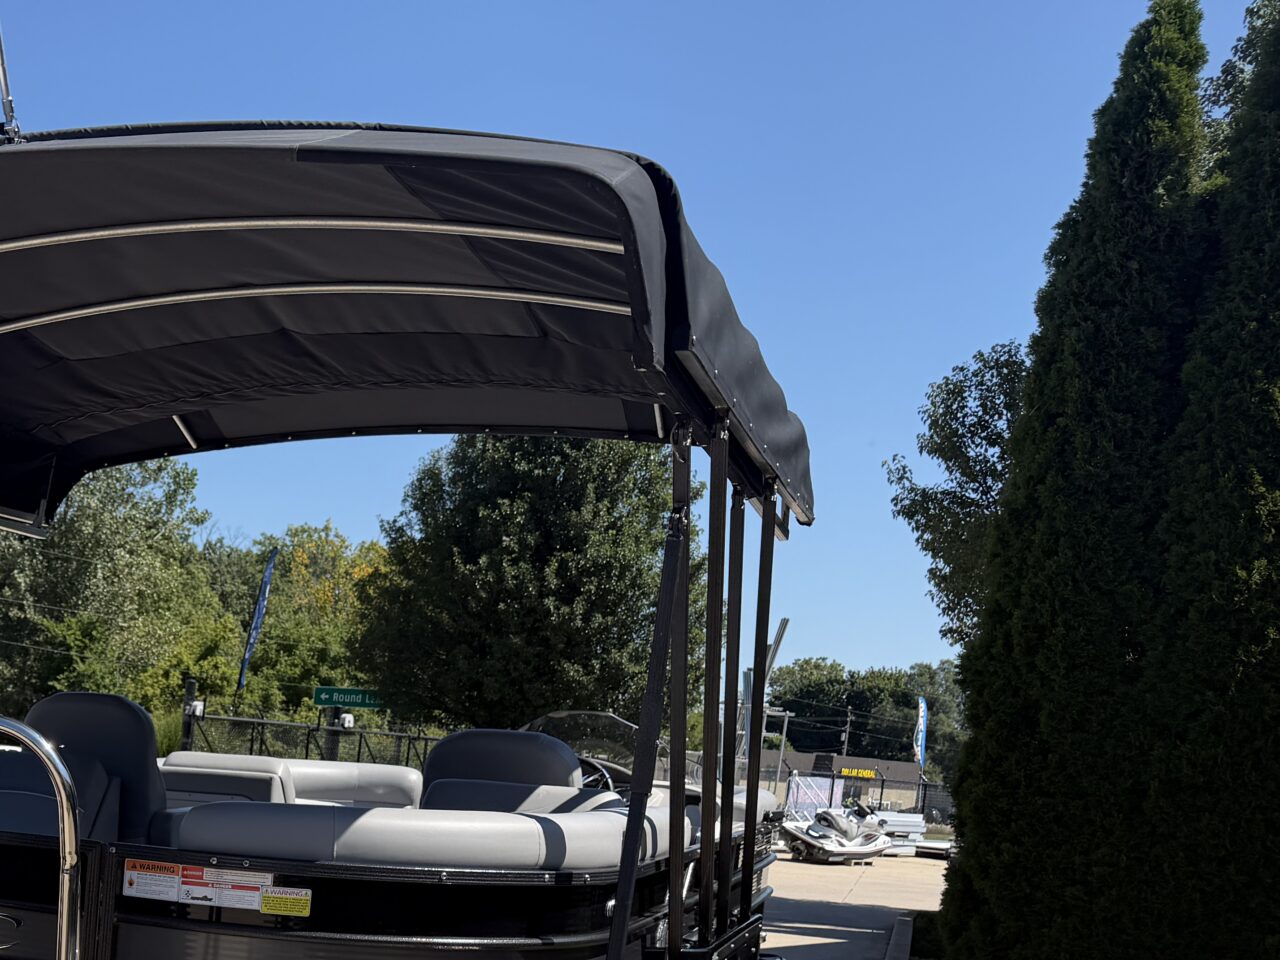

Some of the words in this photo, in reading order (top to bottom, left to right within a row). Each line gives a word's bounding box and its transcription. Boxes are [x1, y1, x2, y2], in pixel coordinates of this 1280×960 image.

[332, 692, 362, 703] Round
[139, 863, 175, 873] WARNING
[271, 889, 304, 897] WARNING
